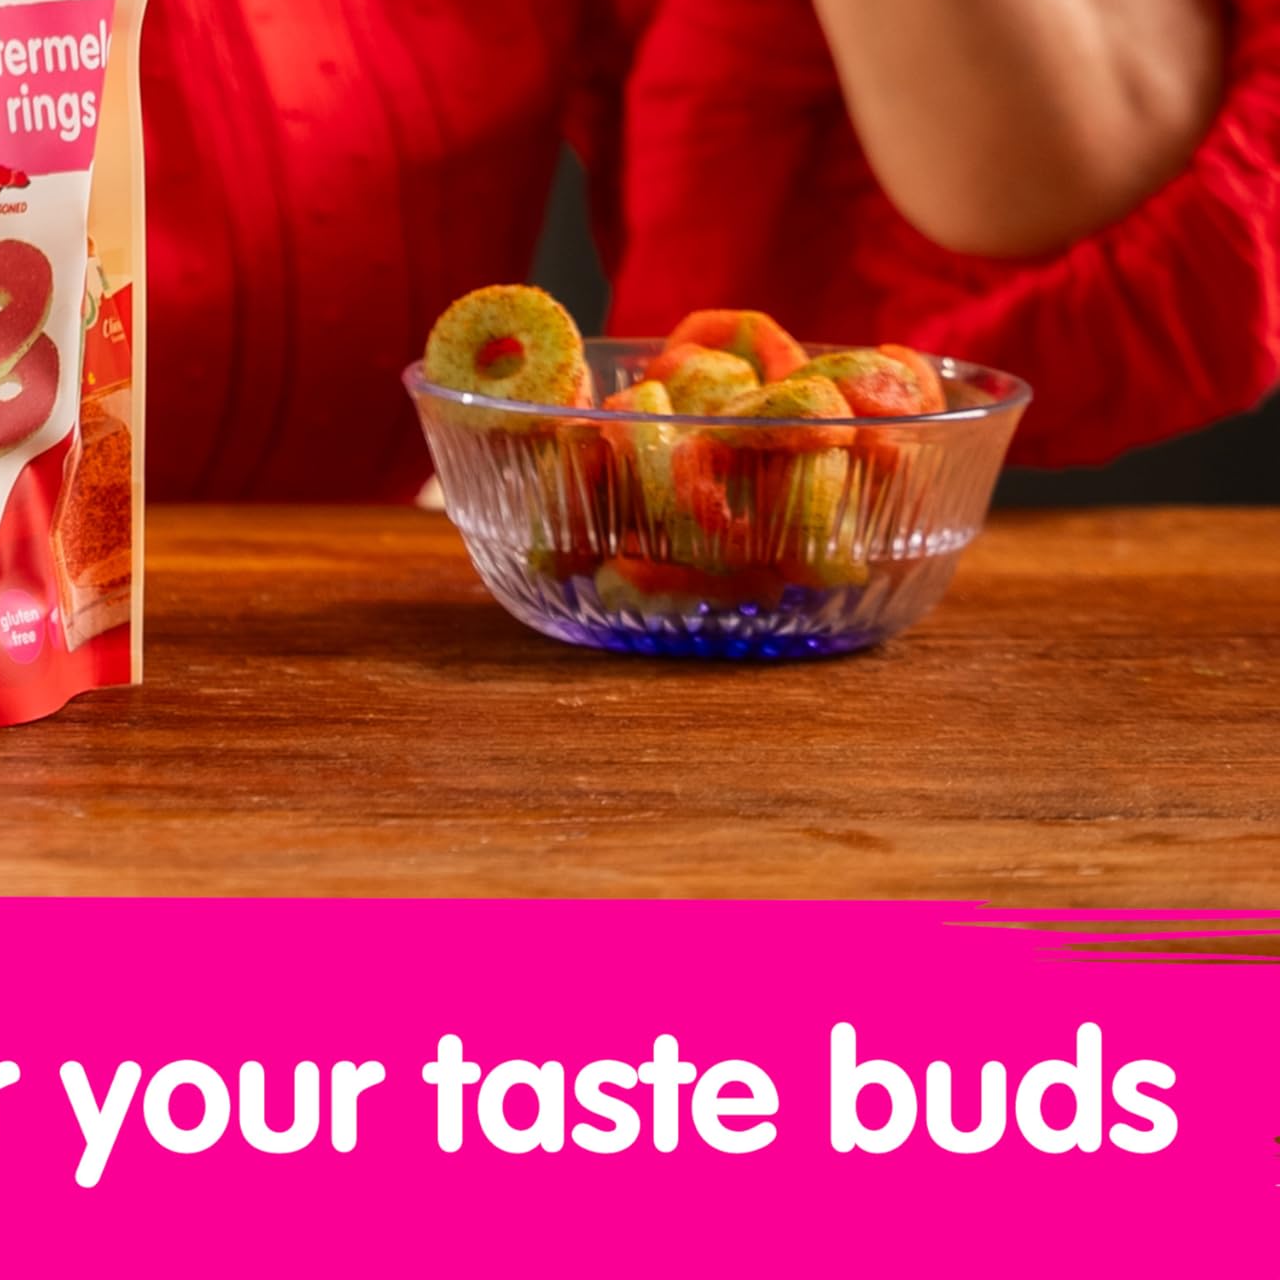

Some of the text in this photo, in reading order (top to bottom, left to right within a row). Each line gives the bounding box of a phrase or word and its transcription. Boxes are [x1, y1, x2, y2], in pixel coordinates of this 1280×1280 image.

[6, 82, 97, 143] rings
[0, 608, 40, 633] gluten
[11, 629, 37, 647] free
